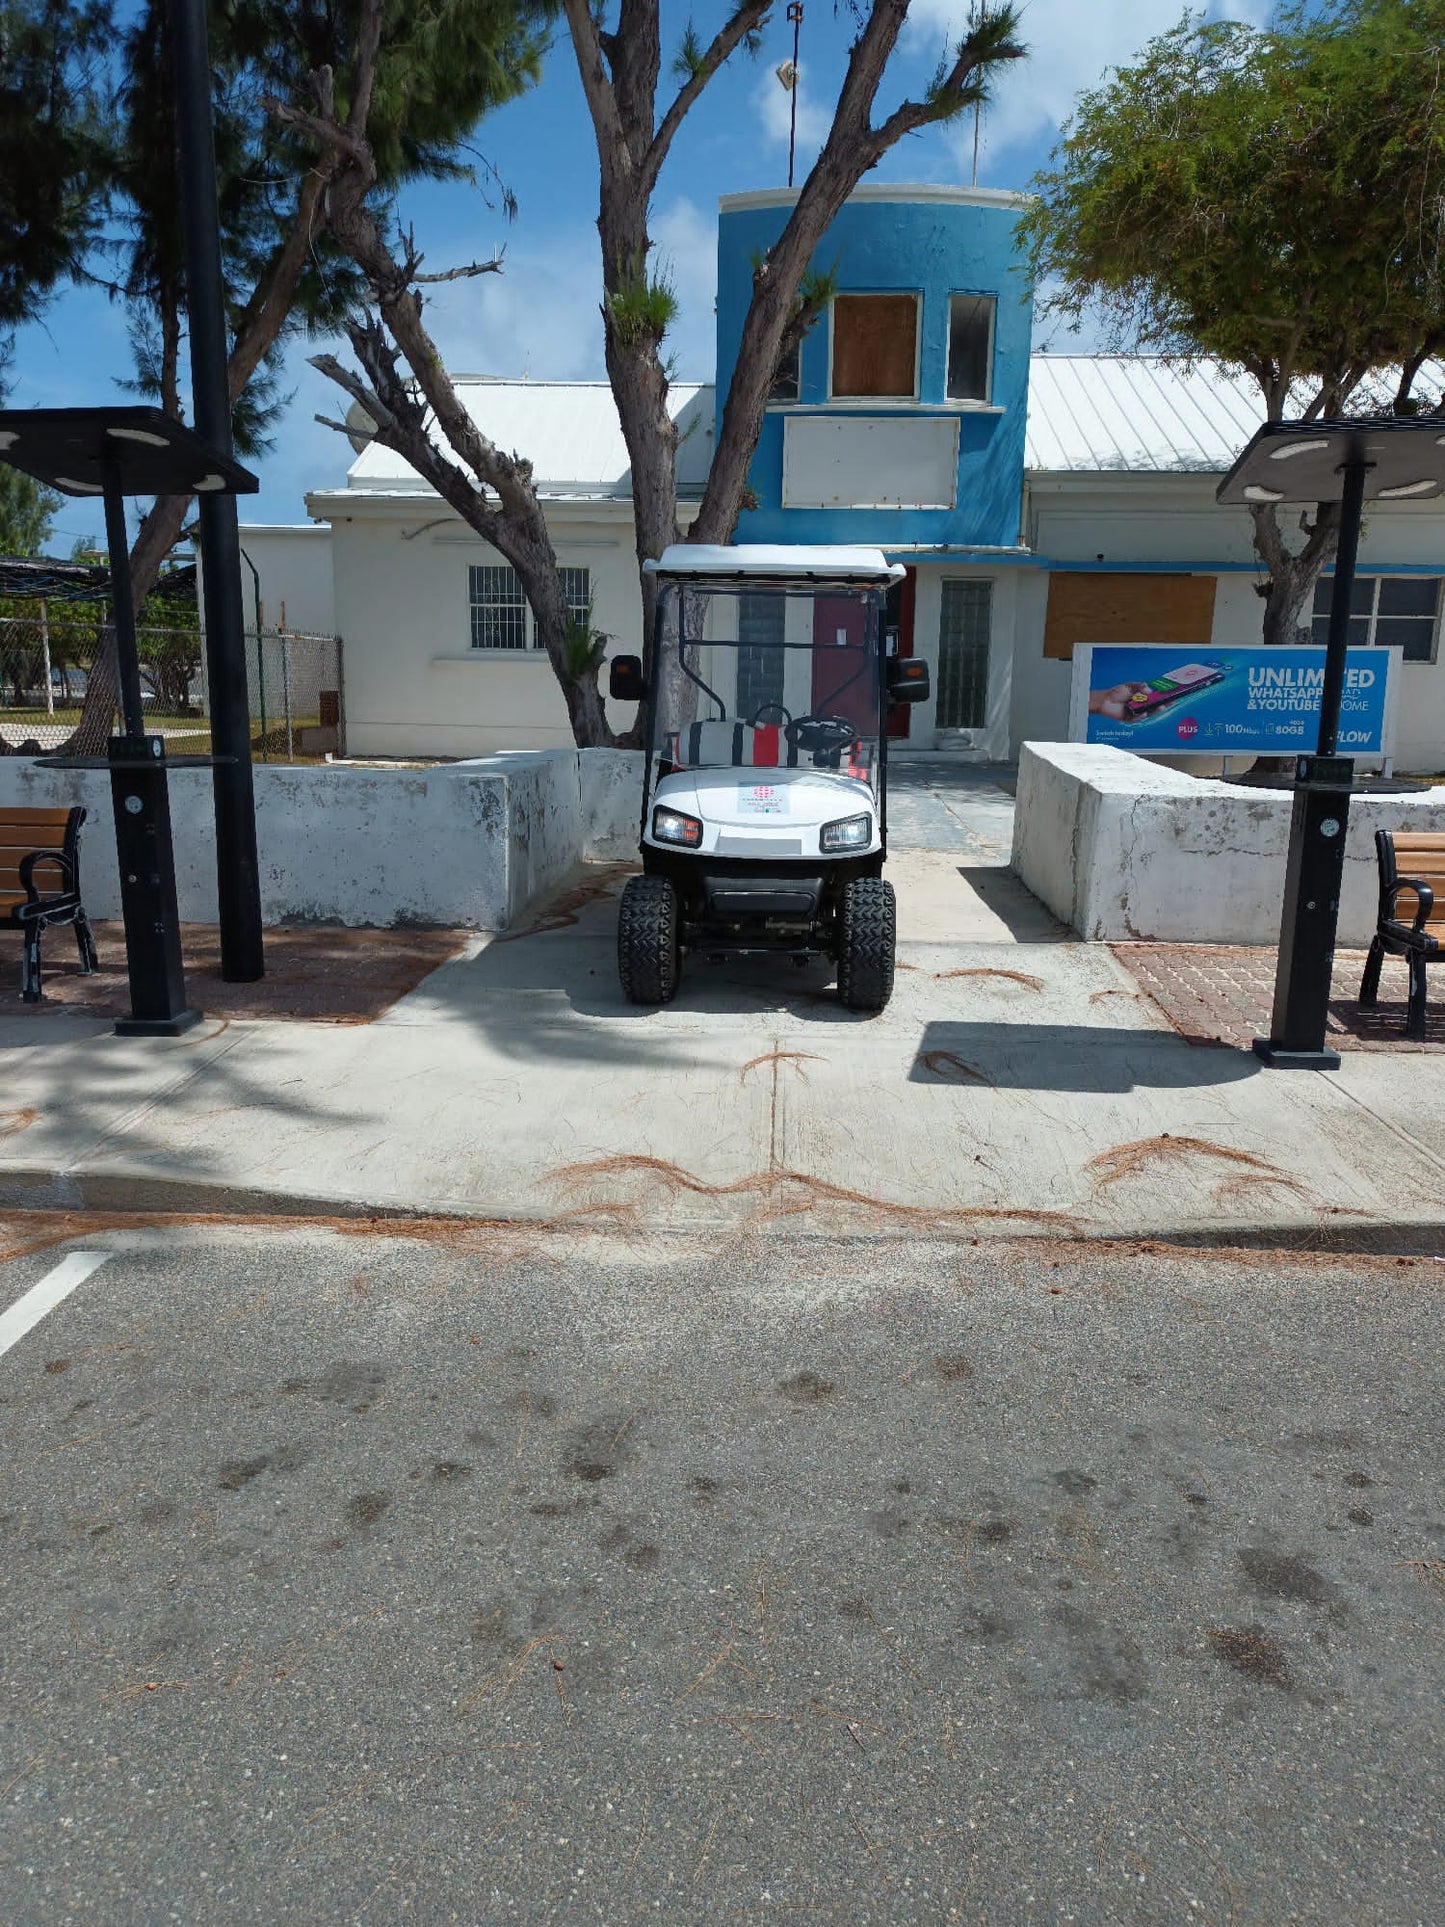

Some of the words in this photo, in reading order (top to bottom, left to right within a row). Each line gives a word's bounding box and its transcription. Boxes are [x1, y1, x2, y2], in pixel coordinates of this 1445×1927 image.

[1249, 667, 1375, 687] UNLIMED
[1249, 687, 1323, 699] WHATSAPP
[1340, 700, 1369, 711] OME
[1178, 725, 1199, 733] PLUS
